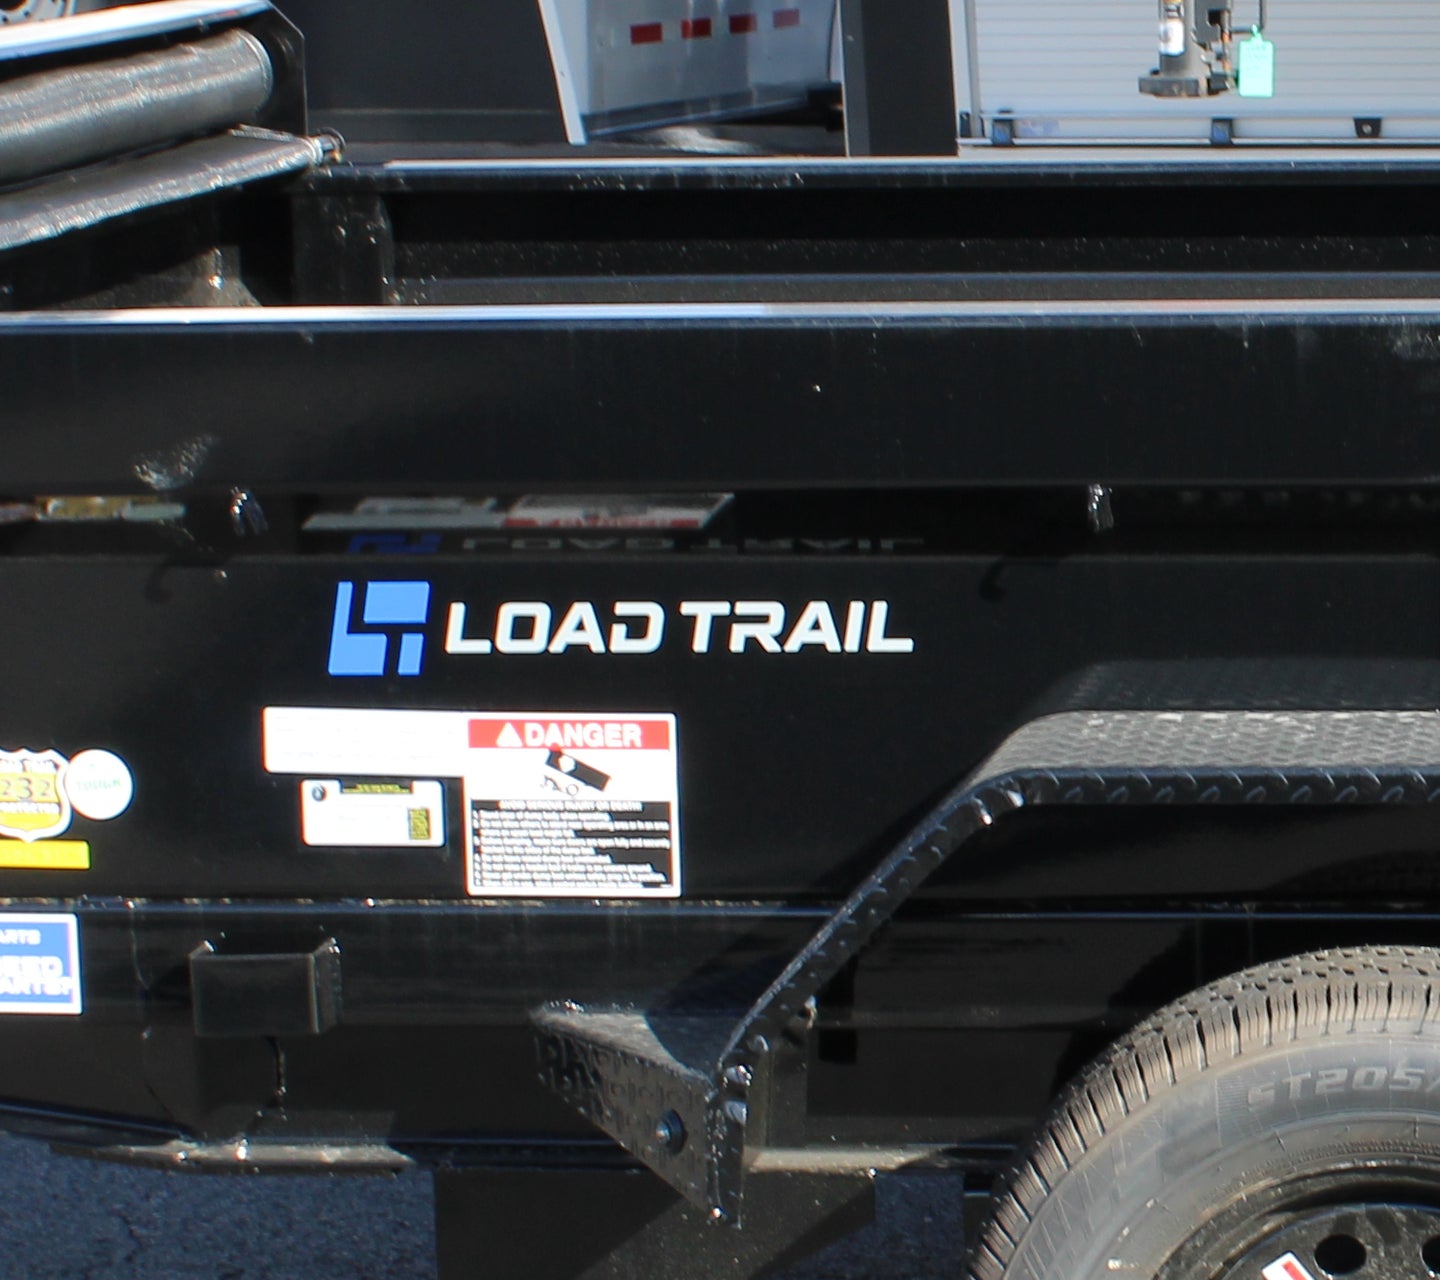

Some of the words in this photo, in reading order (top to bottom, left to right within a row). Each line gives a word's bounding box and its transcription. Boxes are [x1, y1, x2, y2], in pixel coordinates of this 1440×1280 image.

[445, 601, 665, 654] LOAD
[680, 599, 913, 654] TRAIL
[523, 721, 643, 748] DANGER
